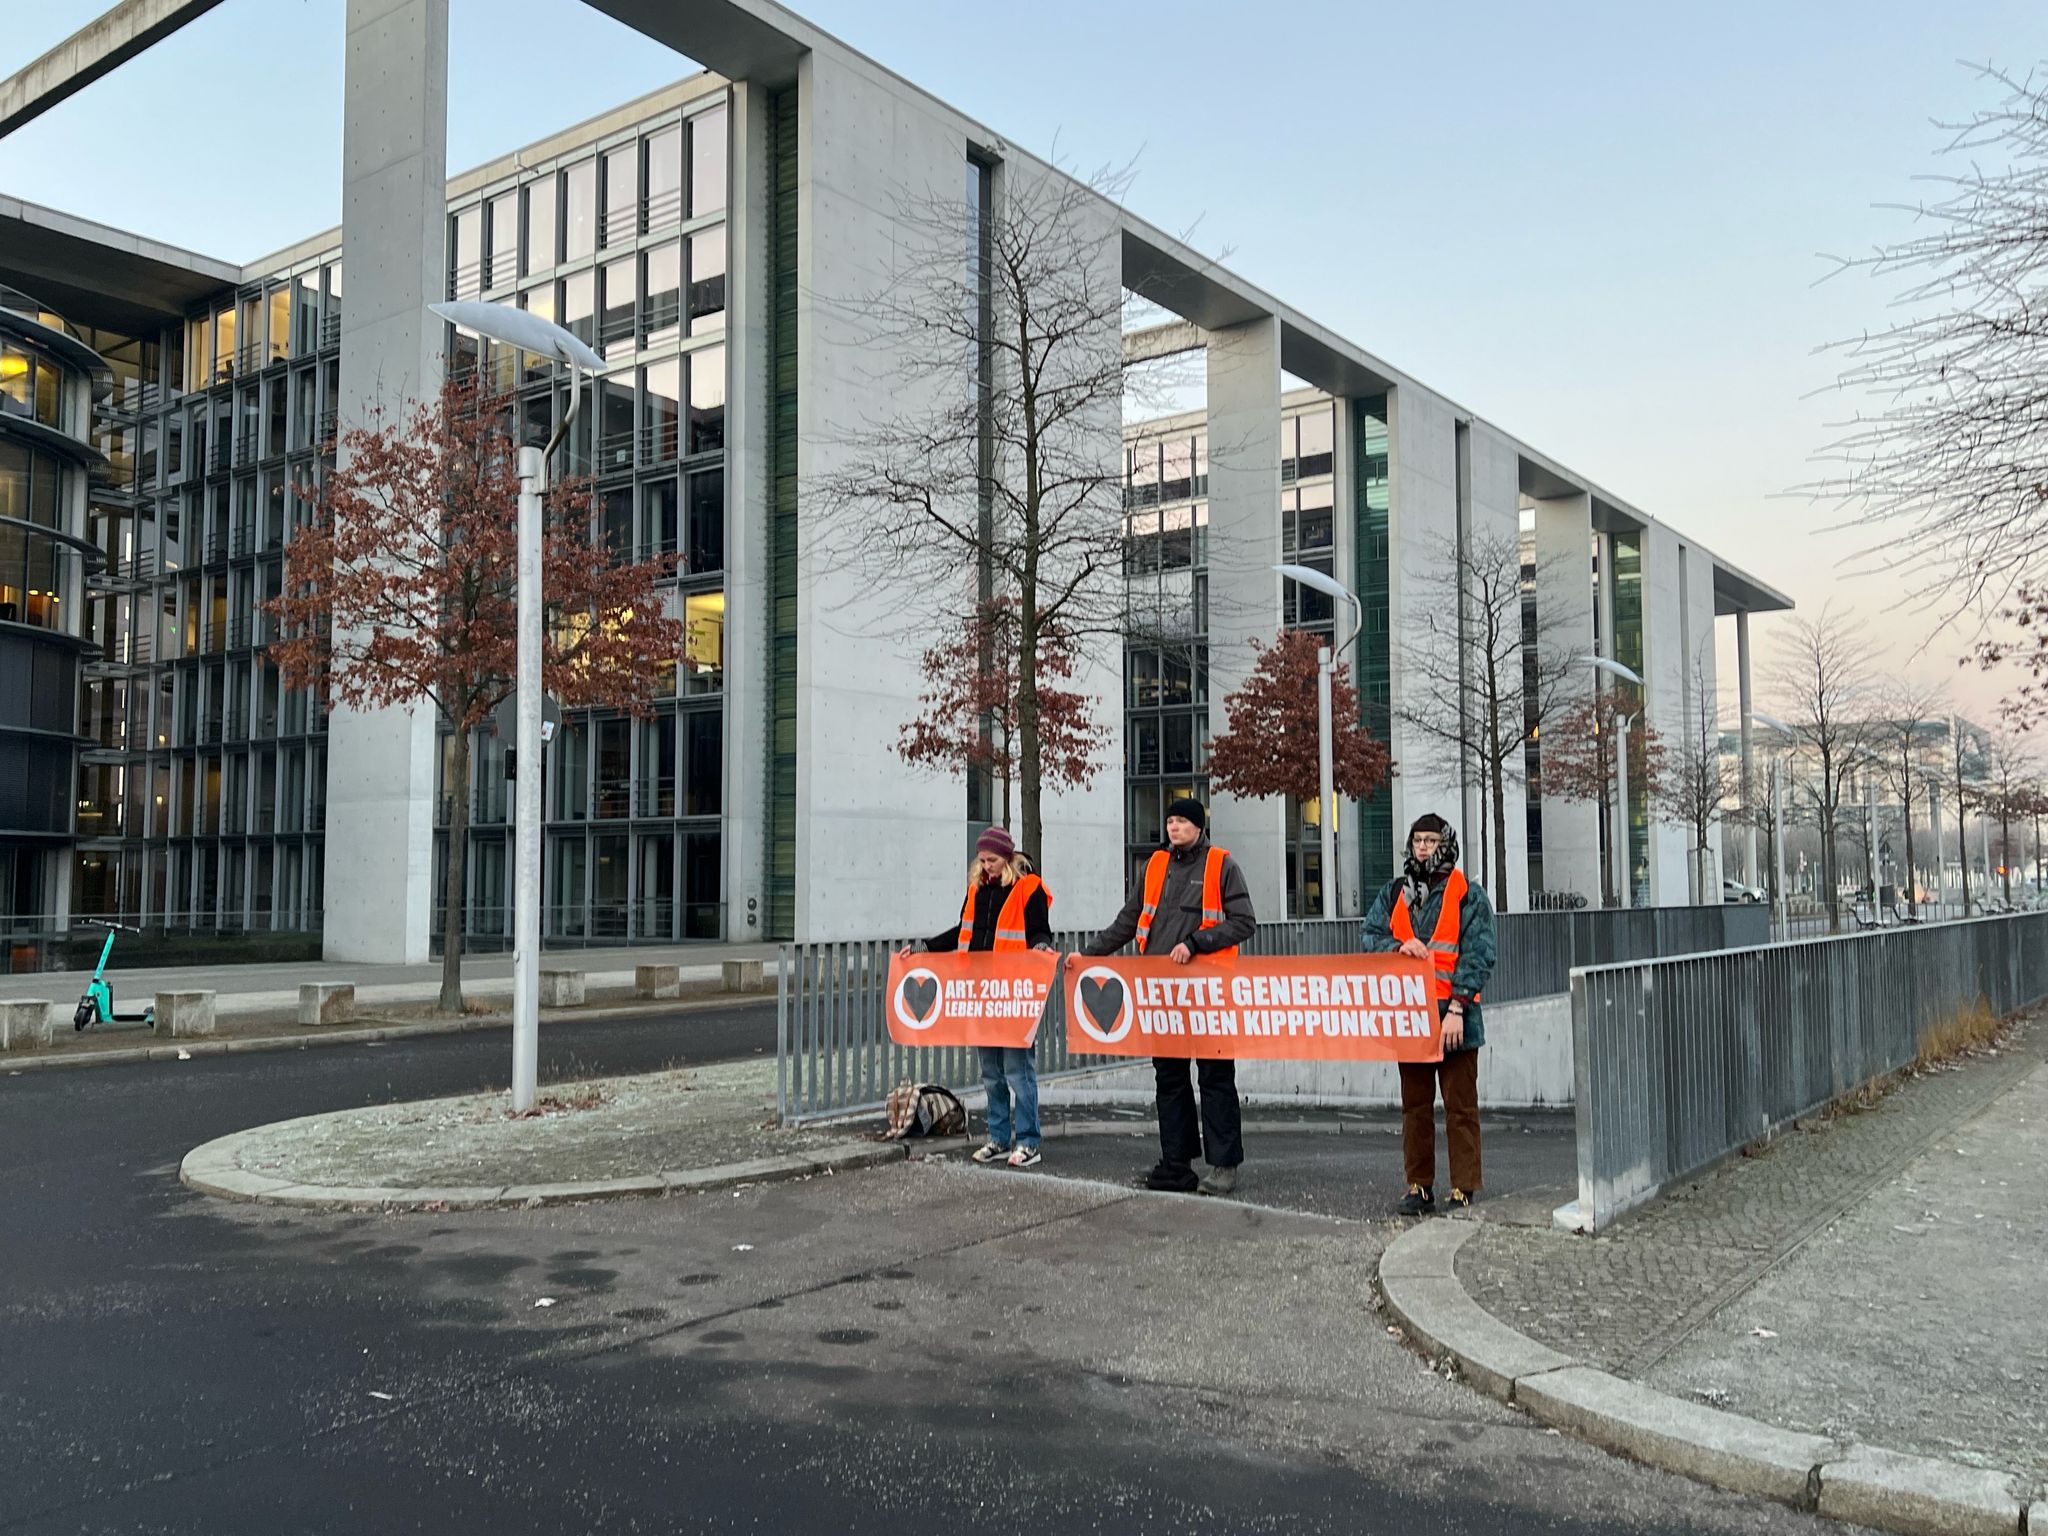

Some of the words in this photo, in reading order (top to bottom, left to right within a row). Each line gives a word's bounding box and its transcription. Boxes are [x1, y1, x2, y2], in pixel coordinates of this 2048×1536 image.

[945, 979, 977, 999] ART.
[980, 979, 1010, 999] 20A
[1013, 978, 1034, 999] GG
[1134, 976, 1225, 1007] LETZTE
[1231, 974, 1427, 1007] GENERATION
[945, 1000, 983, 1018] LEBEN
[1137, 1009, 1185, 1035] VOR
[1188, 1009, 1238, 1036] DEN
[1243, 1009, 1431, 1038] KIPPPUNKTEN
